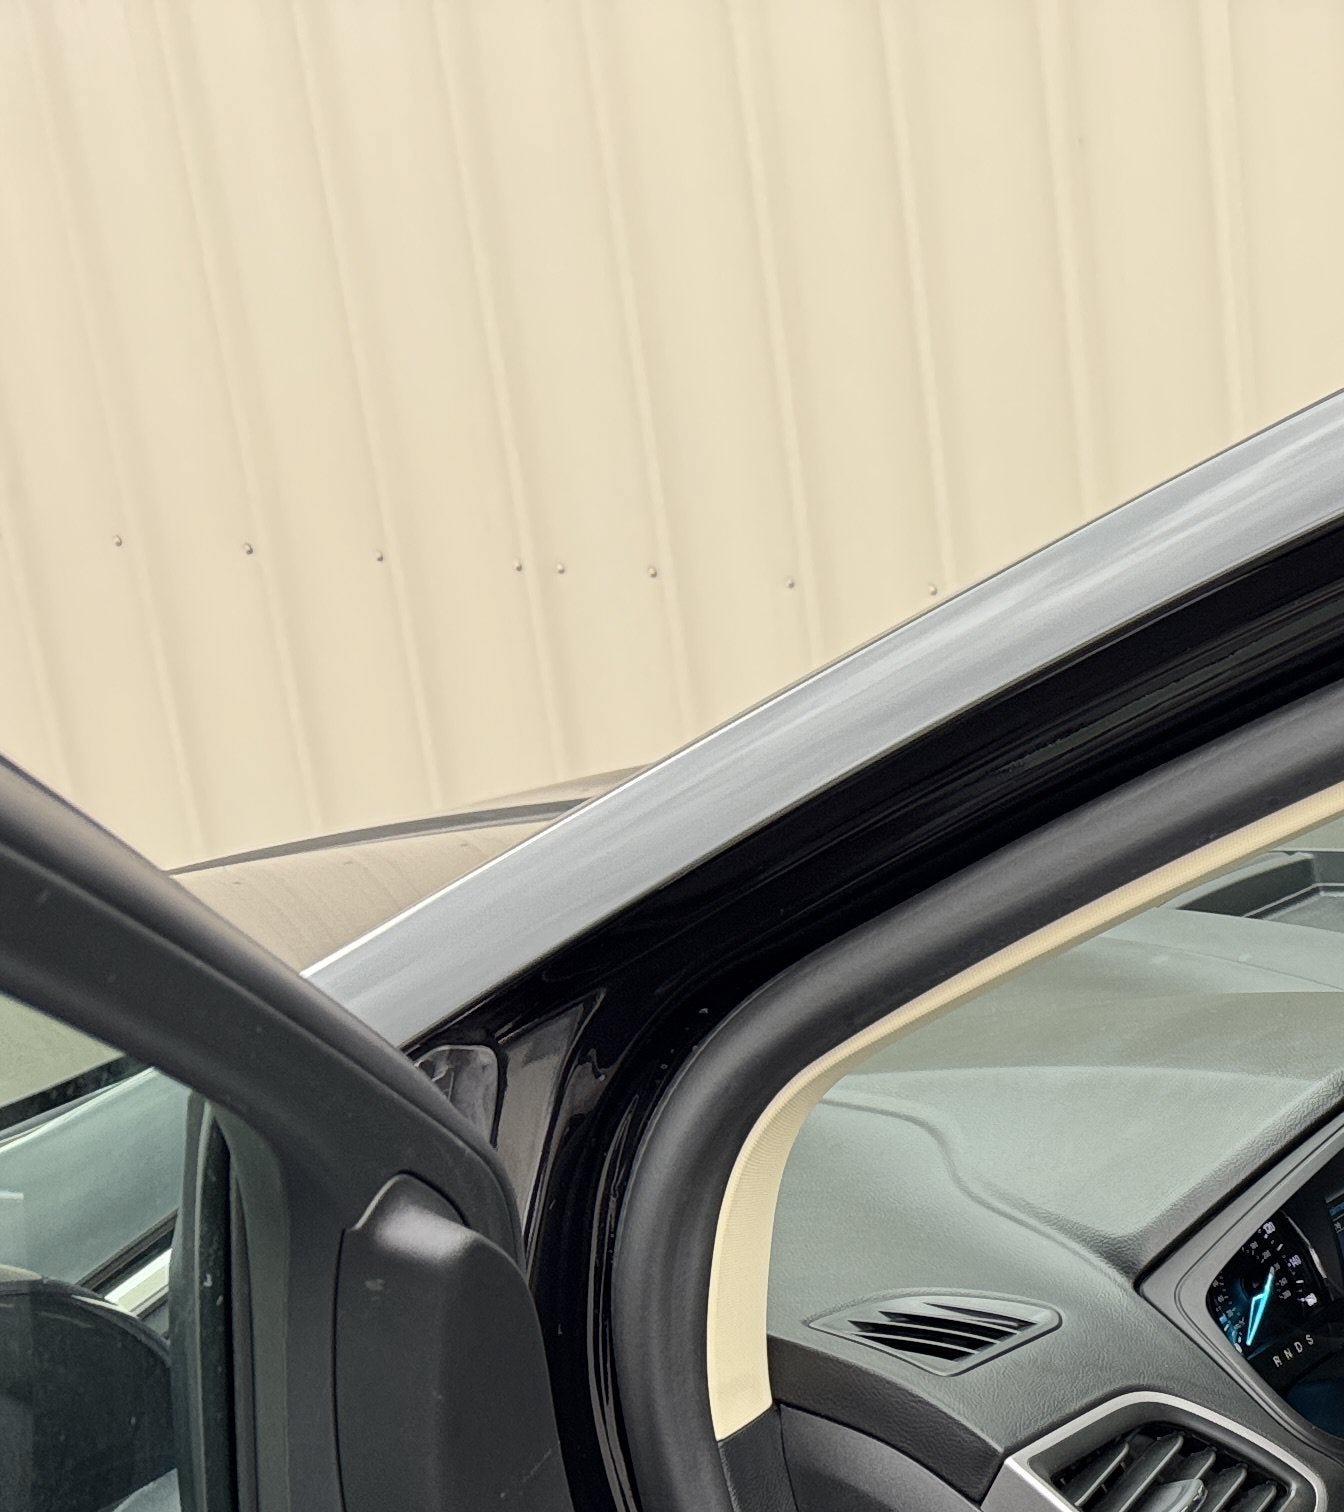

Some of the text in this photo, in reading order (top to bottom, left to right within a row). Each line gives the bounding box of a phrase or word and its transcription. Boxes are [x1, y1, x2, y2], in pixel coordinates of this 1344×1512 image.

[1272, 1334, 1314, 1368] R N D S
